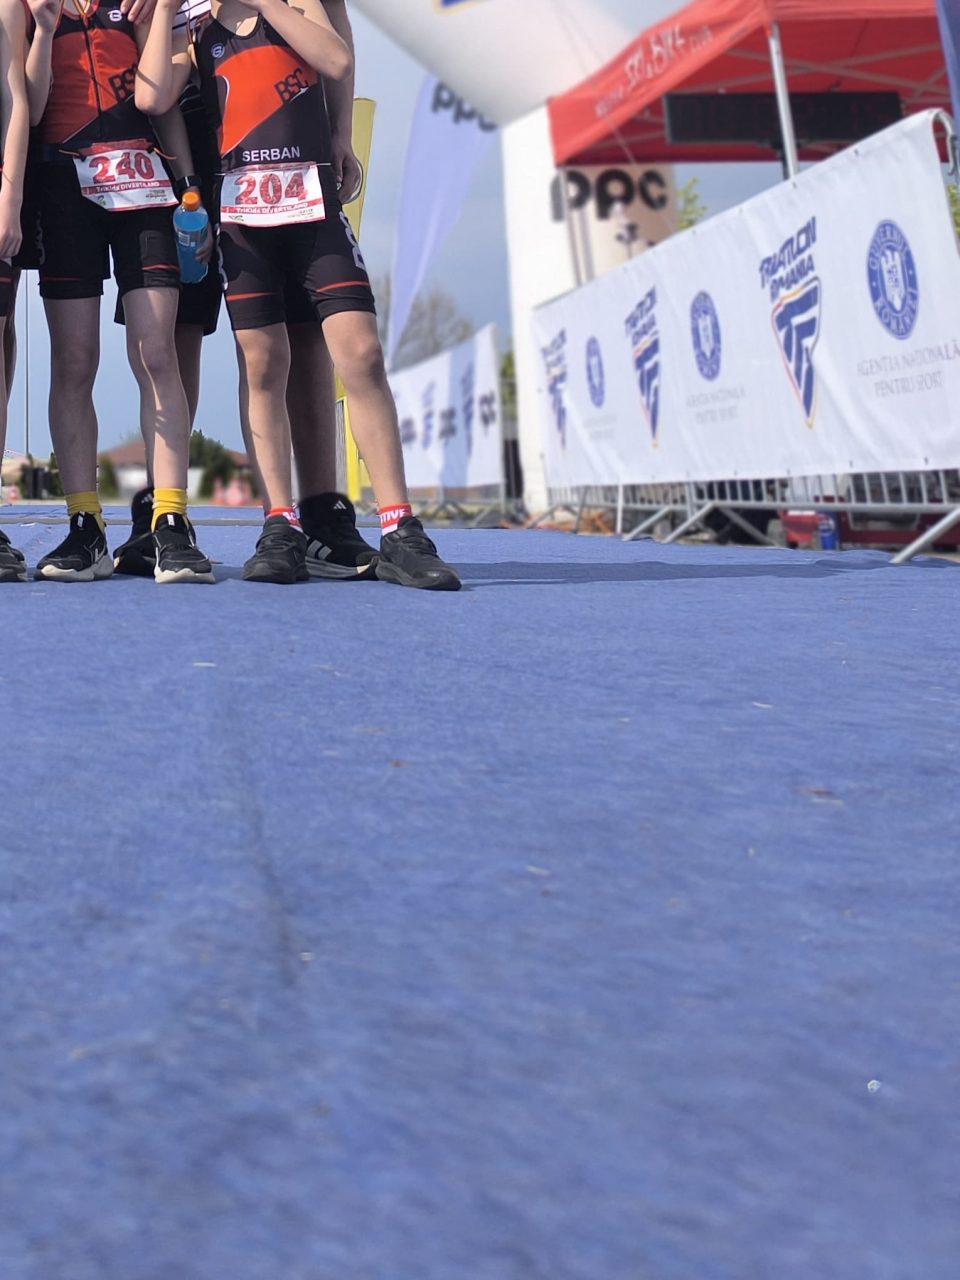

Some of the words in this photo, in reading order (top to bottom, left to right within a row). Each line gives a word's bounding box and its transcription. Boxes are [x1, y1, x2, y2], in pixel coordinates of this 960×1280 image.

[274, 68, 309, 104] BSC
[89, 152, 155, 184] 240
[242, 146, 301, 162] SERBAN
[235, 172, 308, 205] 204
[550, 168, 668, 221] ppc
